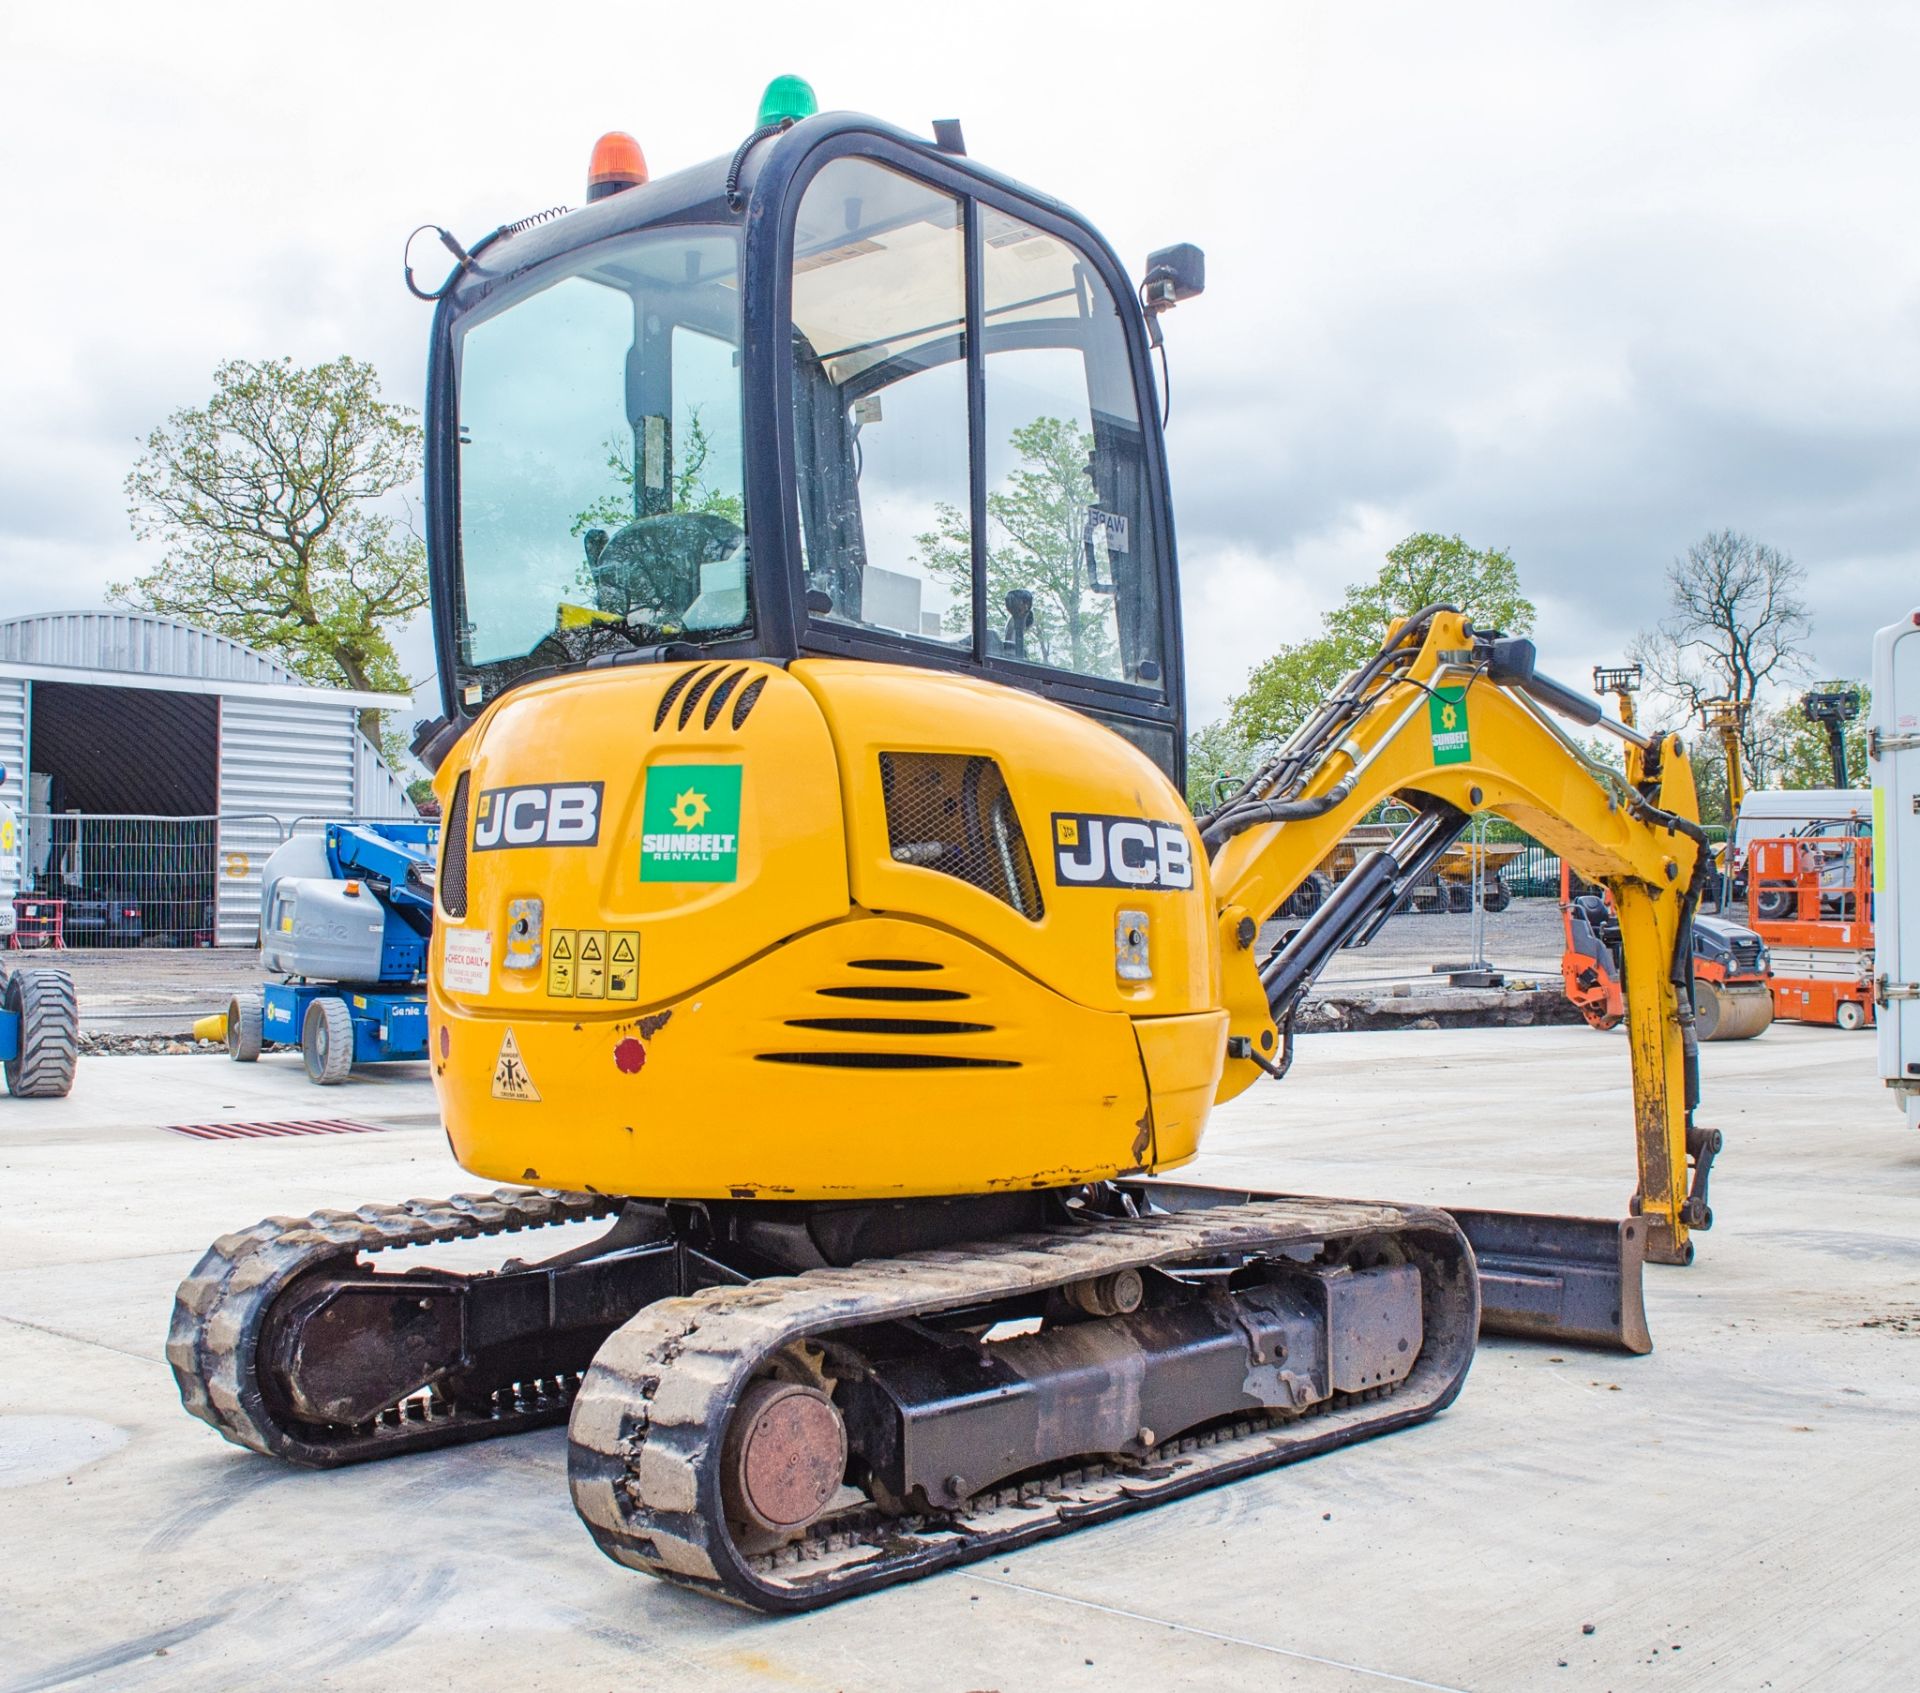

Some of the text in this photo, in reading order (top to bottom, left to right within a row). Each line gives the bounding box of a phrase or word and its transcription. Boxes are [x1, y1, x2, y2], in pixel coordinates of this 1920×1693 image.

[1432, 731, 1468, 746] SUNBELT
[1438, 743, 1464, 751] RENTALS
[476, 787, 598, 847] JCB
[643, 834, 735, 853] SUNBELT
[653, 853, 720, 861] RENTALS
[1059, 820, 1191, 888] JCB
[448, 953, 484, 966] CHECK DAILY
[392, 1006, 420, 1016] Genie
